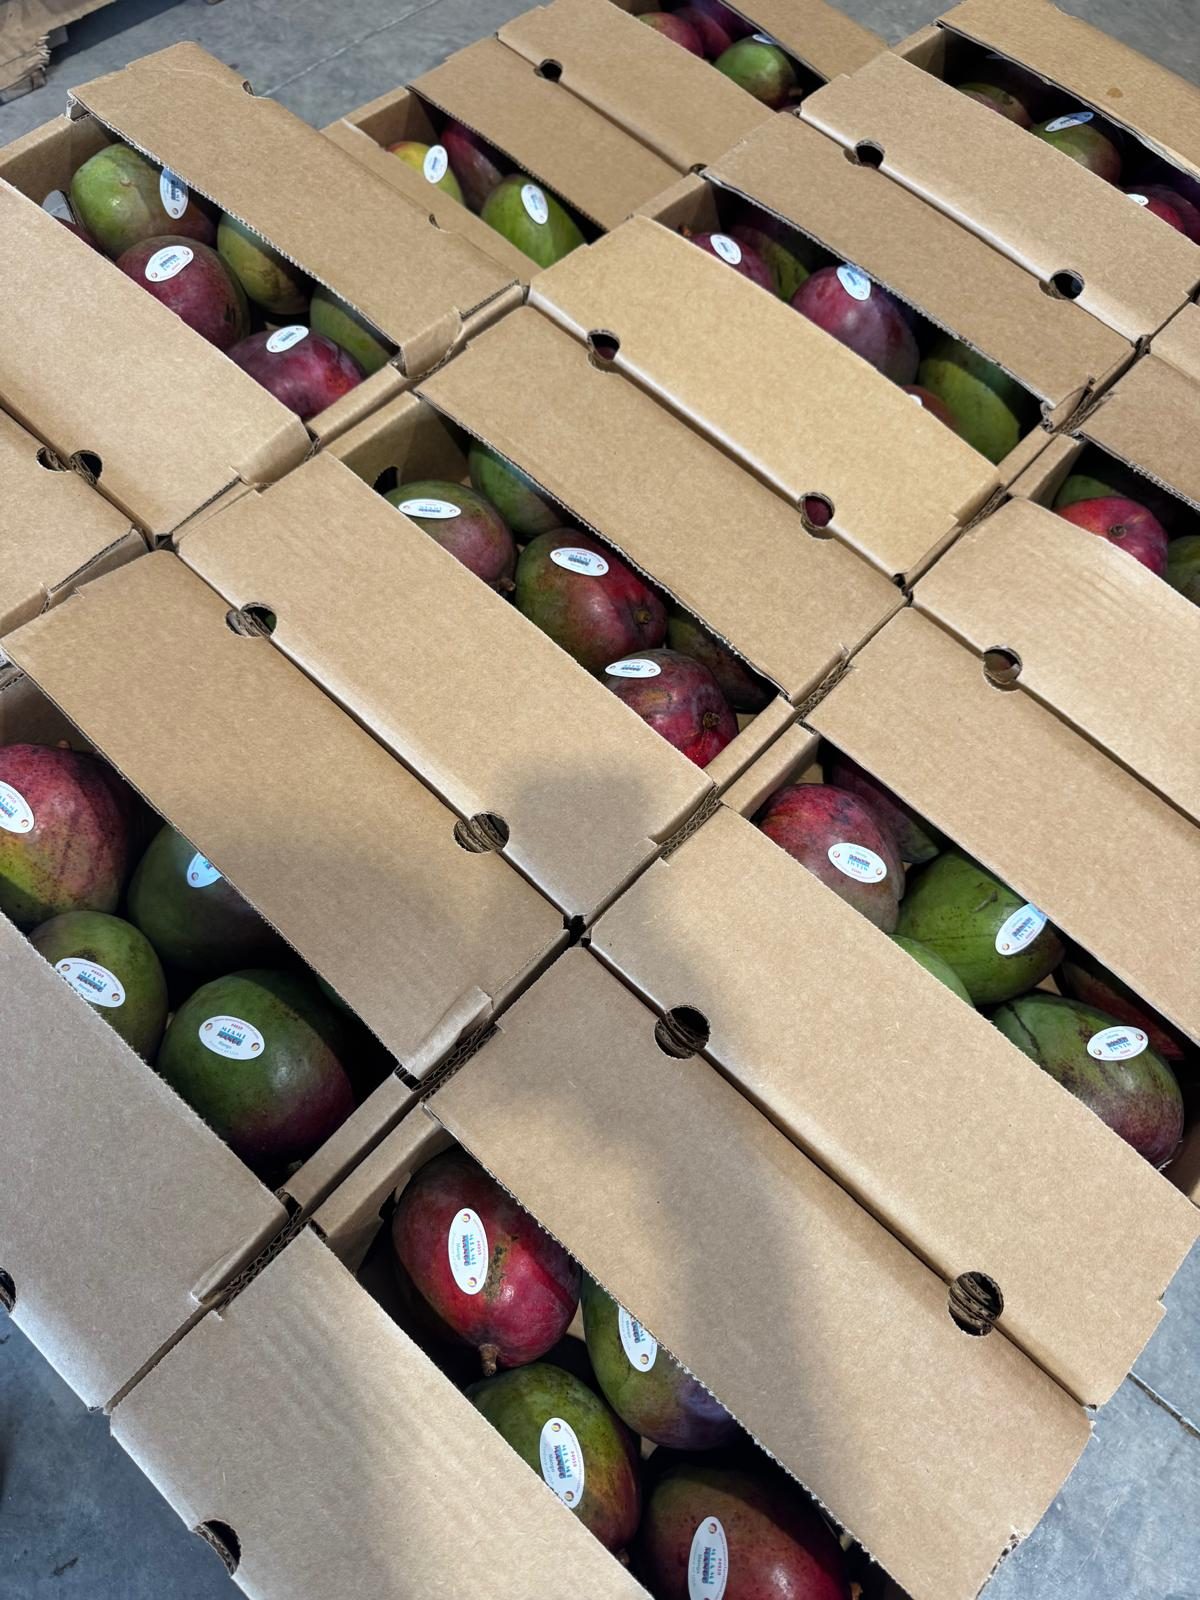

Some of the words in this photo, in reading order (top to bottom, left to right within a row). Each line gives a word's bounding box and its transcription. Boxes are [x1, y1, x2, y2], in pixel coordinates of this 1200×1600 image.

[76, 974, 105, 992] MANGO
[81, 970, 107, 987] MIAMI
[216, 1030, 243, 1046] MANGO
[221, 1026, 247, 1040] MIAMI
[462, 1234, 471, 1266] MANGO
[469, 1233, 477, 1265] MIAMI
[553, 1445, 567, 1479] MANGO
[562, 1444, 573, 1478] MIAMI
[701, 1547, 711, 1584] MANGO
[708, 1548, 717, 1585] MIAMI
